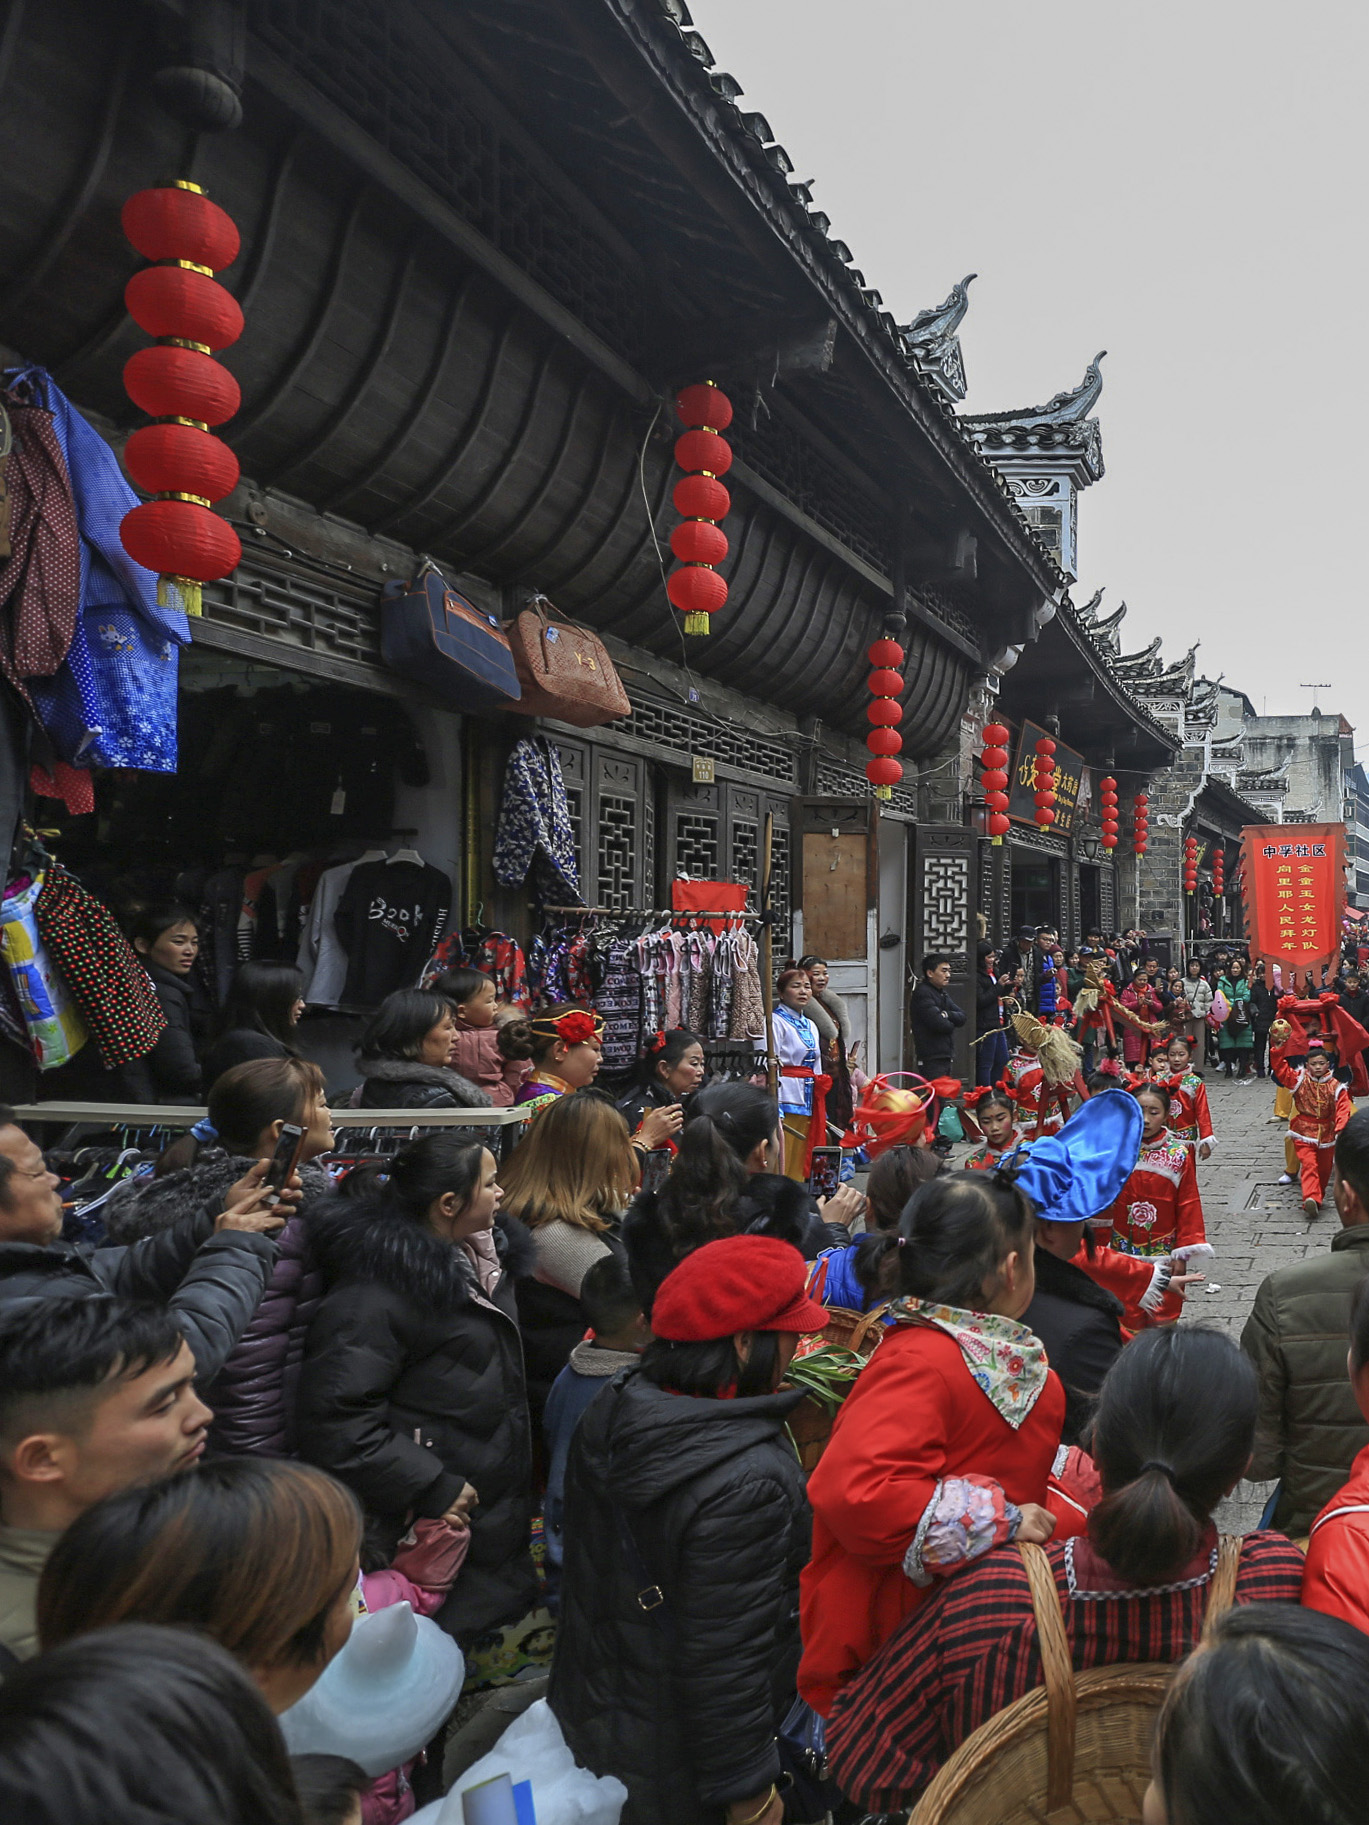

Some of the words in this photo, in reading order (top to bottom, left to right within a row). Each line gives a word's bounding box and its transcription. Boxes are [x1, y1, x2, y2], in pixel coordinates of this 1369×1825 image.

[1263, 844, 1326, 858] 中孚社区
[1276, 864, 1298, 951] 向里耶人民拜年
[1297, 864, 1320, 951] 金童玉女龙灯队
